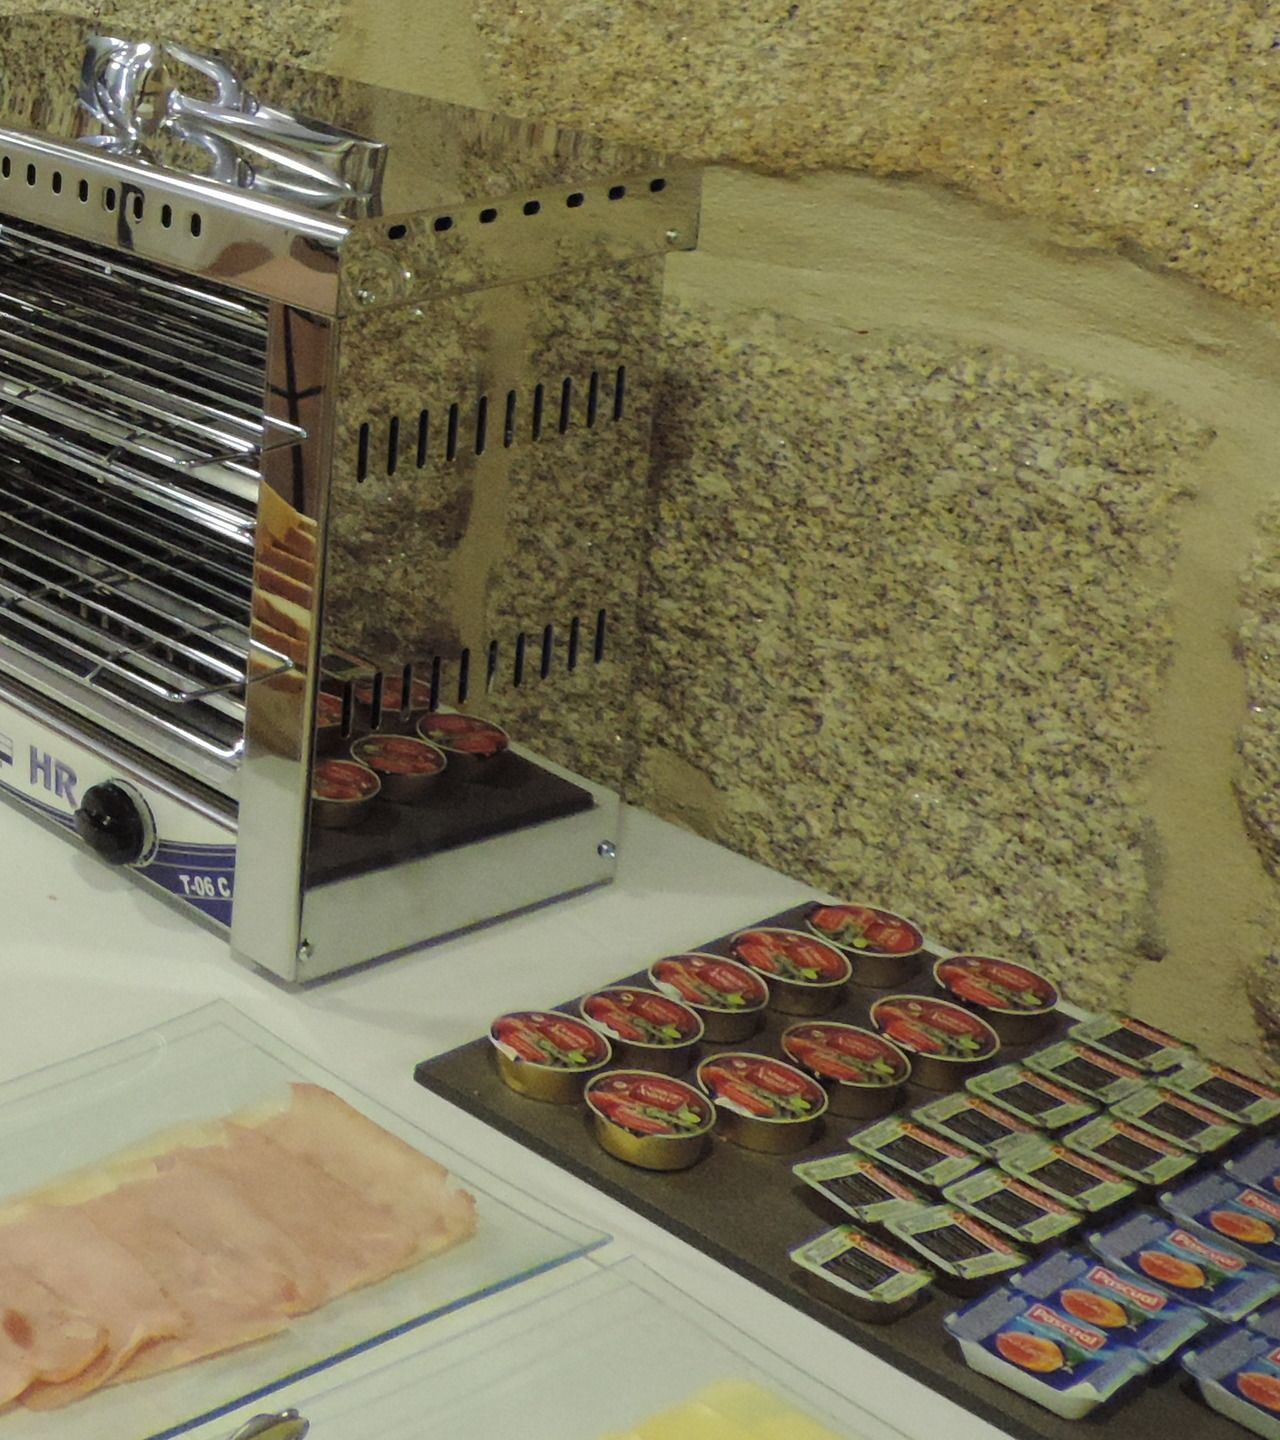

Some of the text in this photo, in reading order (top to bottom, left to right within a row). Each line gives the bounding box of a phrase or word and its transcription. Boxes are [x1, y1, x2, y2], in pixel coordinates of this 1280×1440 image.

[29, 744, 79, 809] HR
[178, 874, 215, 897] T-06
[1095, 1270, 1158, 1307] Pascual
[1033, 1307, 1098, 1346] Pascual
